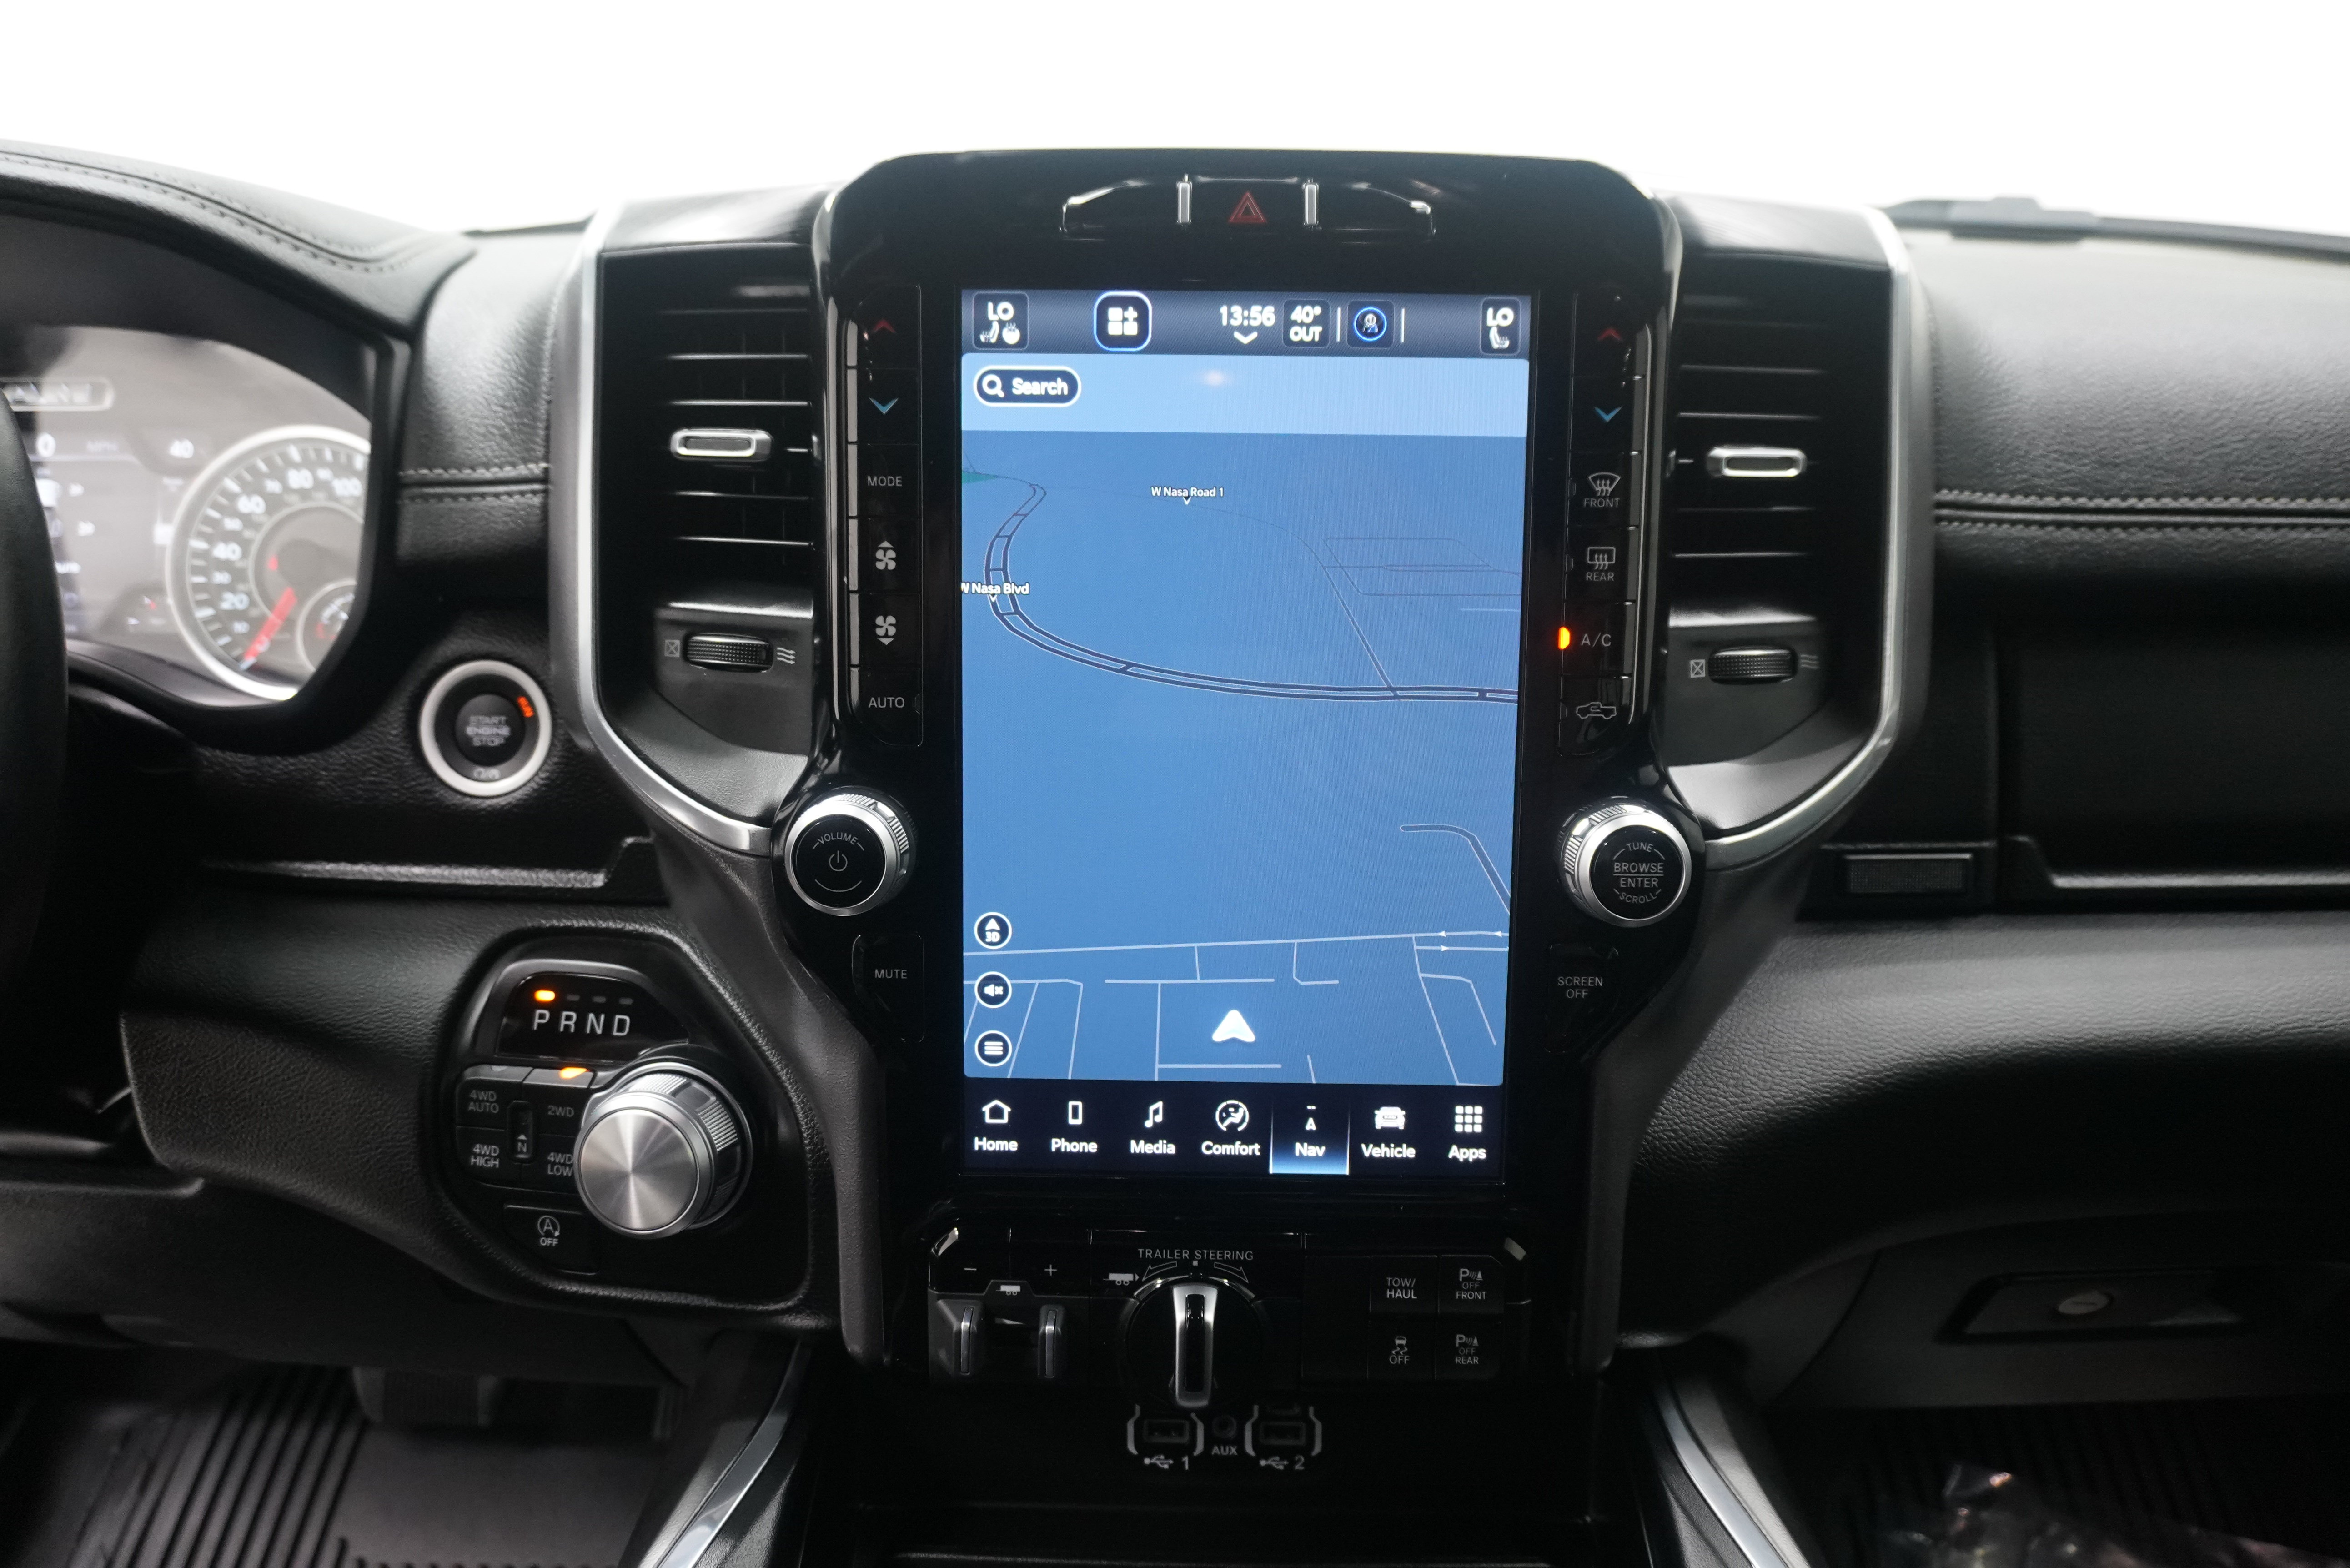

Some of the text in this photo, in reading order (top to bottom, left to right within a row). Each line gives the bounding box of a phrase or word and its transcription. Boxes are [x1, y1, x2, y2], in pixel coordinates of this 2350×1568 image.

[987, 302, 1014, 322] LO
[1220, 305, 1276, 327] 13:56
[1290, 305, 1321, 323] 40°
[1486, 307, 1514, 328] LO
[1289, 326, 1323, 342] OUT
[1012, 377, 1068, 395] Search
[286, 468, 314, 489] 80
[867, 476, 902, 487] MODE
[1151, 487, 1224, 497] W Nasa Road 1
[237, 494, 266, 514] 60
[1584, 498, 1620, 508] FRONT
[213, 542, 242, 560] 40
[1586, 572, 1614, 581] REAR
[972, 583, 1001, 594] Nasa
[1003, 583, 1029, 594] Blvd
[220, 592, 249, 610] 20
[1581, 633, 1611, 647] A/C
[868, 697, 905, 708] AUTO
[817, 832, 858, 845] VOLUME
[1626, 842, 1653, 853] TUNE
[1614, 862, 1664, 873] BROWSE
[1620, 877, 1658, 888] ENTER
[1619, 892, 1657, 904] SCROLL
[985, 931, 1000, 942] 3D
[875, 969, 907, 979] MUTE
[1558, 976, 1603, 987] SCREEN
[1566, 989, 1588, 999] OFF
[469, 1090, 497, 1101] 4WD
[468, 1102, 499, 1113] AUTO
[548, 1105, 574, 1117] 2WD
[974, 1136, 1018, 1151] Home
[1051, 1138, 1098, 1153] Phone
[1130, 1139, 1175, 1154] Media
[1201, 1141, 1260, 1156] Comfort
[1295, 1142, 1326, 1157] Nav
[472, 1144, 500, 1156] 4WD
[1361, 1143, 1416, 1158] Vehicle
[1448, 1145, 1486, 1162] Apps
[470, 1155, 500, 1169] HIGH
[547, 1151, 573, 1165] 4WD
[547, 1165, 573, 1177] LOW
[540, 1237, 558, 1246] OFF
[1138, 1248, 1254, 1261] TRAILER STEERING
[1387, 1289, 1417, 1299] HAUL
[1456, 1291, 1487, 1300] FRONT
[1389, 1355, 1410, 1364] OFF
[1456, 1356, 1479, 1365] REAR
[1211, 1446, 1238, 1455] AUX
[1182, 1456, 1189, 1470] 1
[1295, 1455, 1305, 1470] 2
